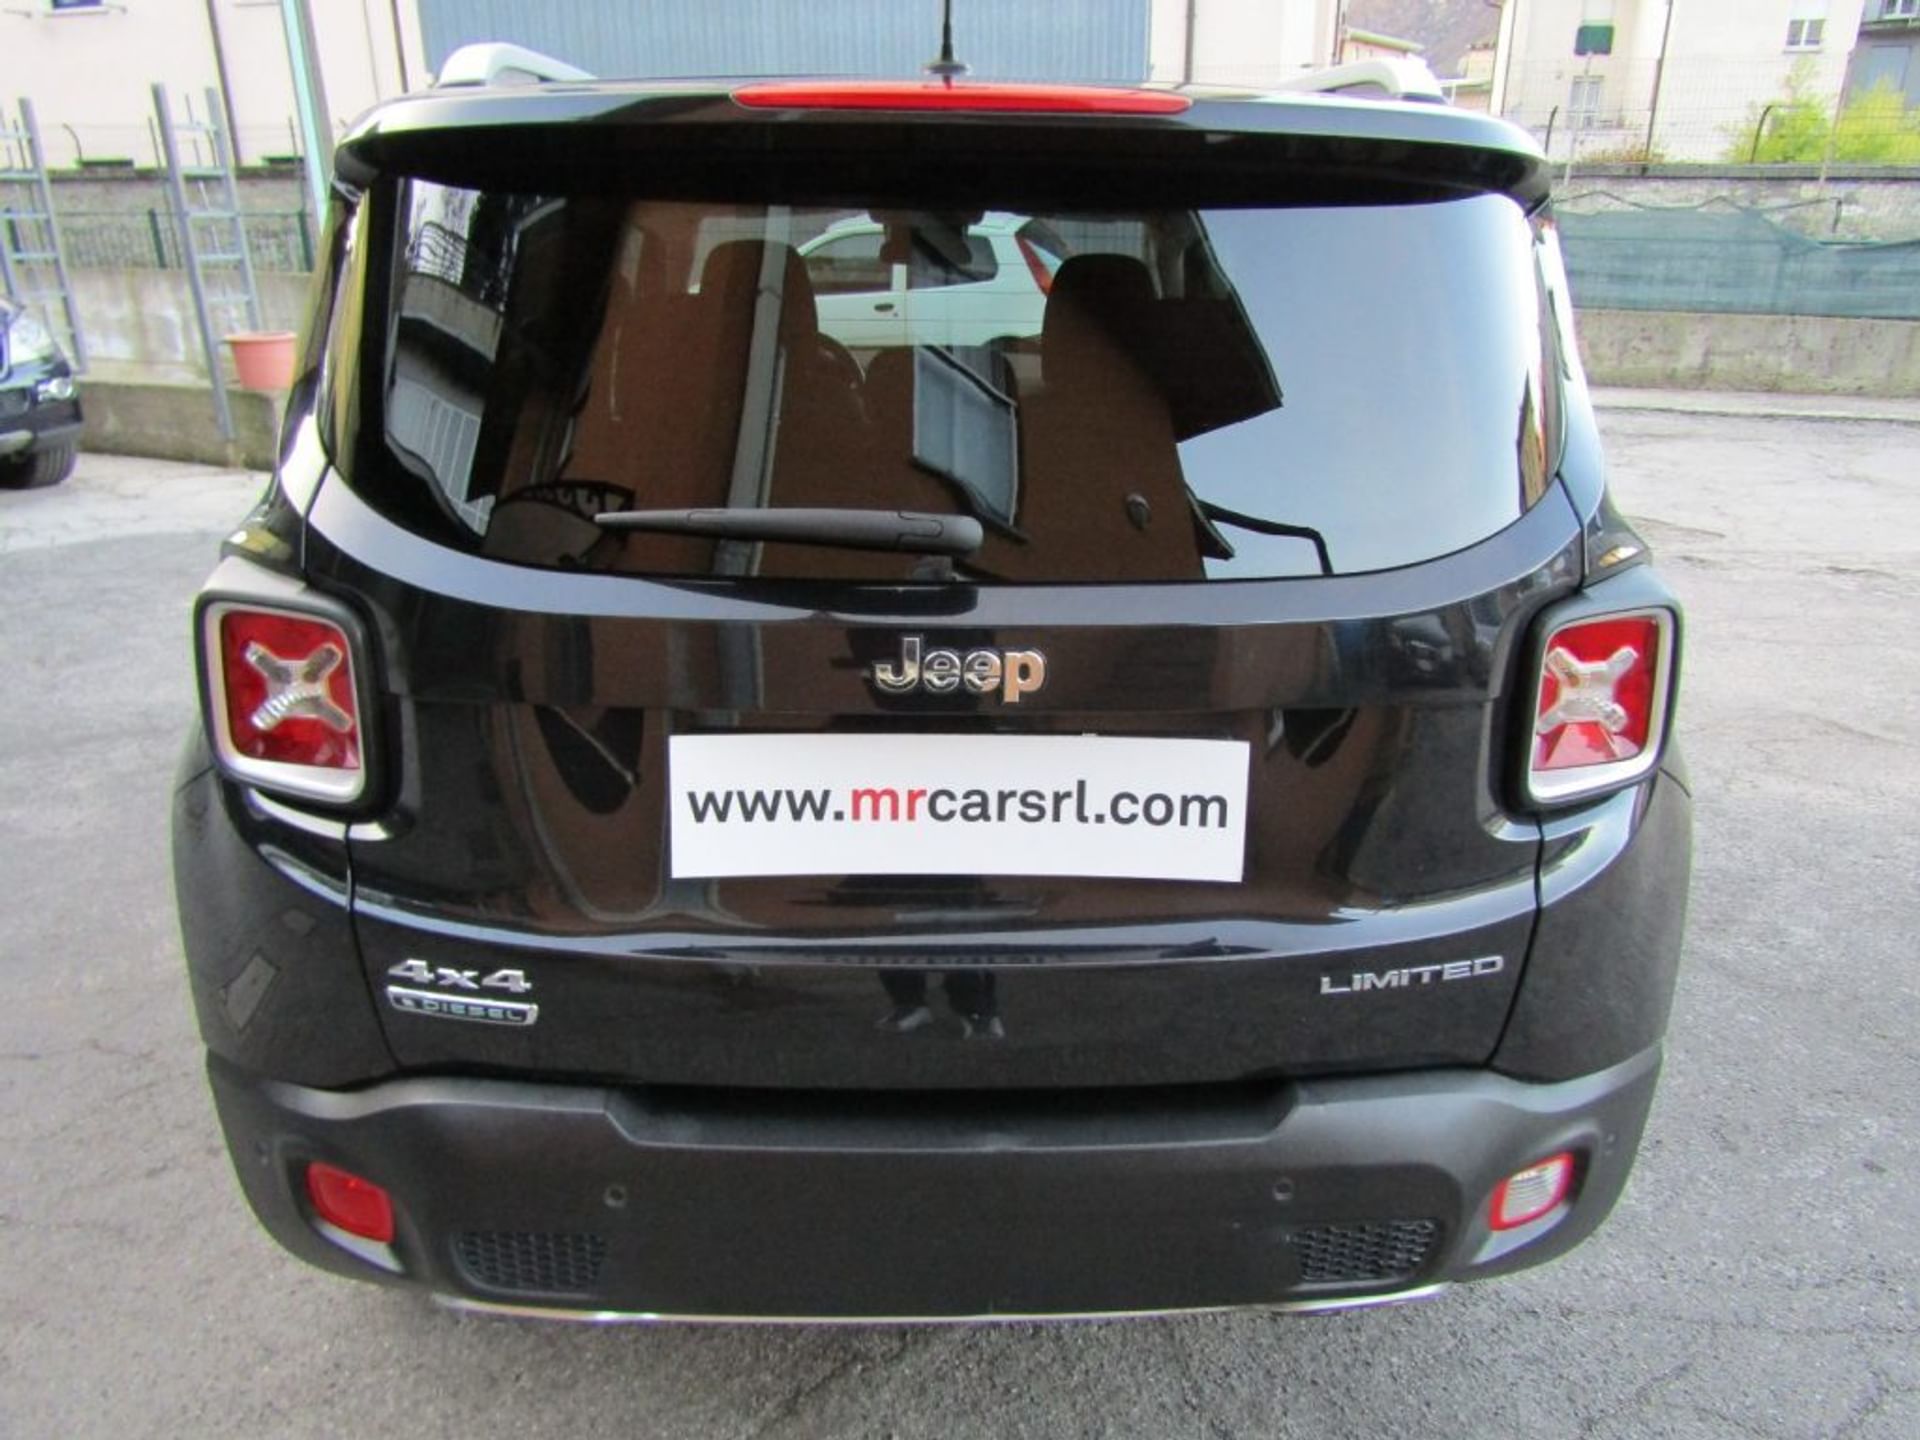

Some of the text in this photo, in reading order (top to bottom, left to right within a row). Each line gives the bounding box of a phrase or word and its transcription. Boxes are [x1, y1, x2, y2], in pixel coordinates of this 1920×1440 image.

[874, 637, 1045, 702] Jeep
[687, 780, 1229, 828] www.mrcarsrl.com
[1320, 955, 1504, 994] LIMITED
